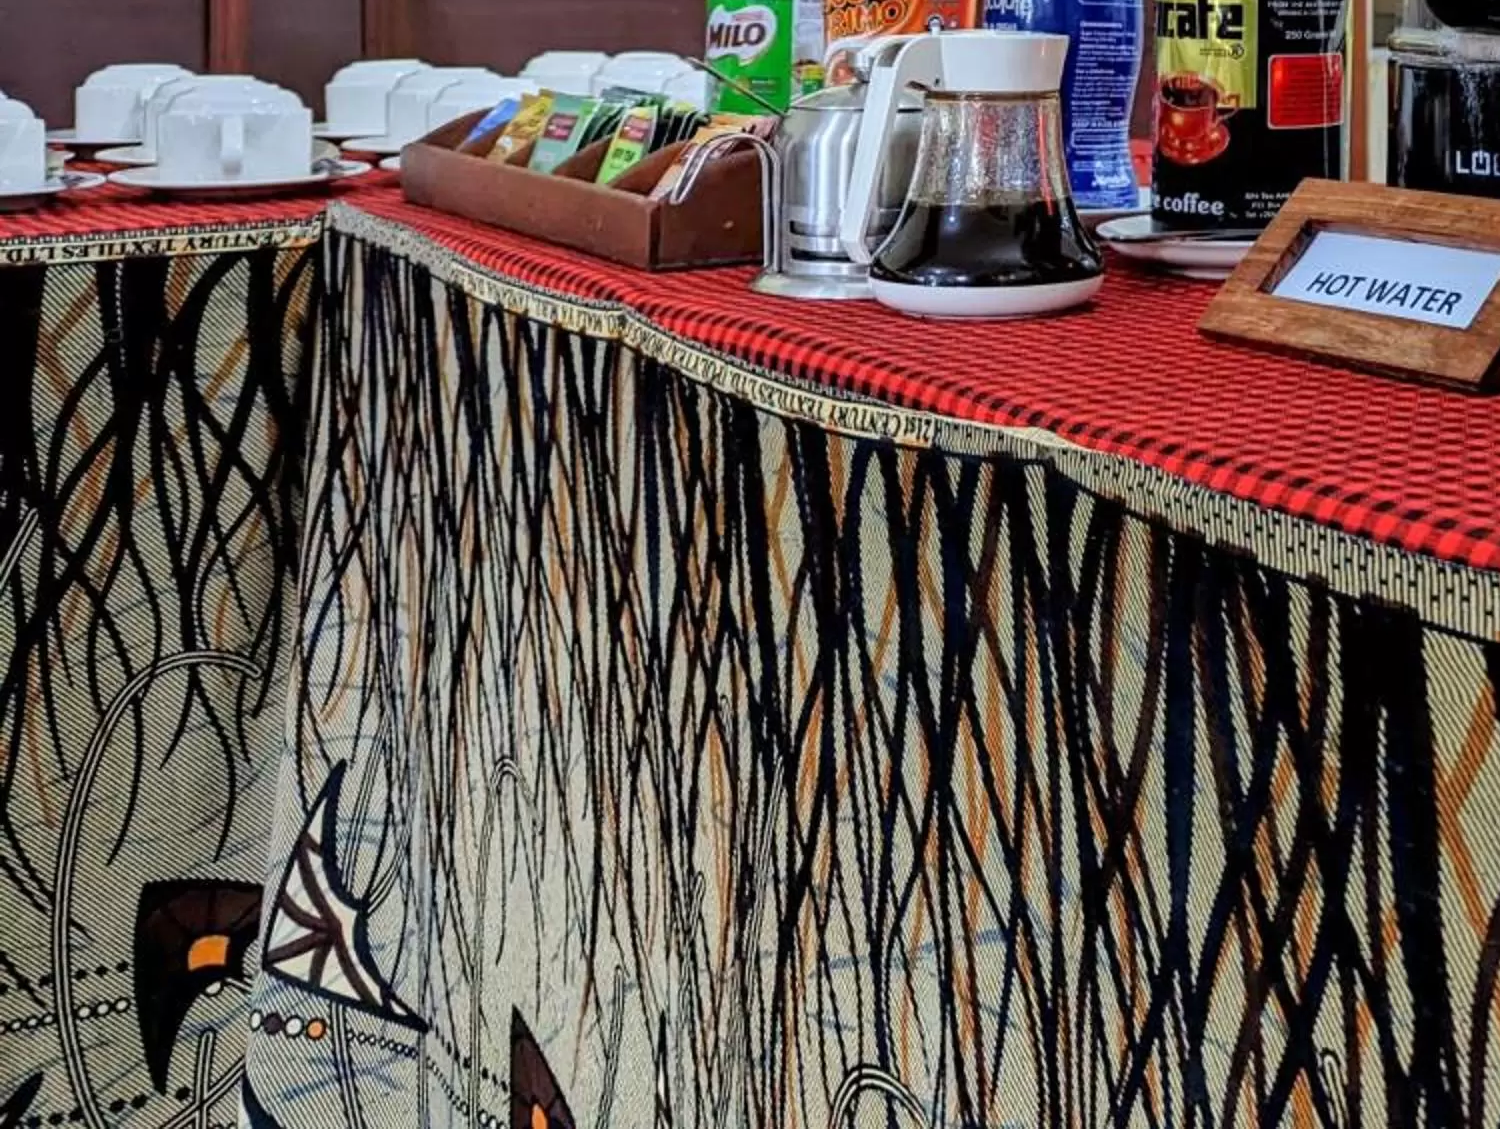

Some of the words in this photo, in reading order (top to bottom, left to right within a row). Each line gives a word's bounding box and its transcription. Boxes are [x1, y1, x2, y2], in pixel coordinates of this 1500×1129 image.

[709, 21, 765, 50] MILO
[1163, 192, 1225, 215] coffee
[62, 237, 177, 260] TEXTILES
[182, 230, 288, 252] CENTURY
[1306, 271, 1366, 298] HOT
[1365, 278, 1463, 316] WATER
[757, 382, 824, 422] TEXTILES
[827, 405, 902, 439] CENTURY
